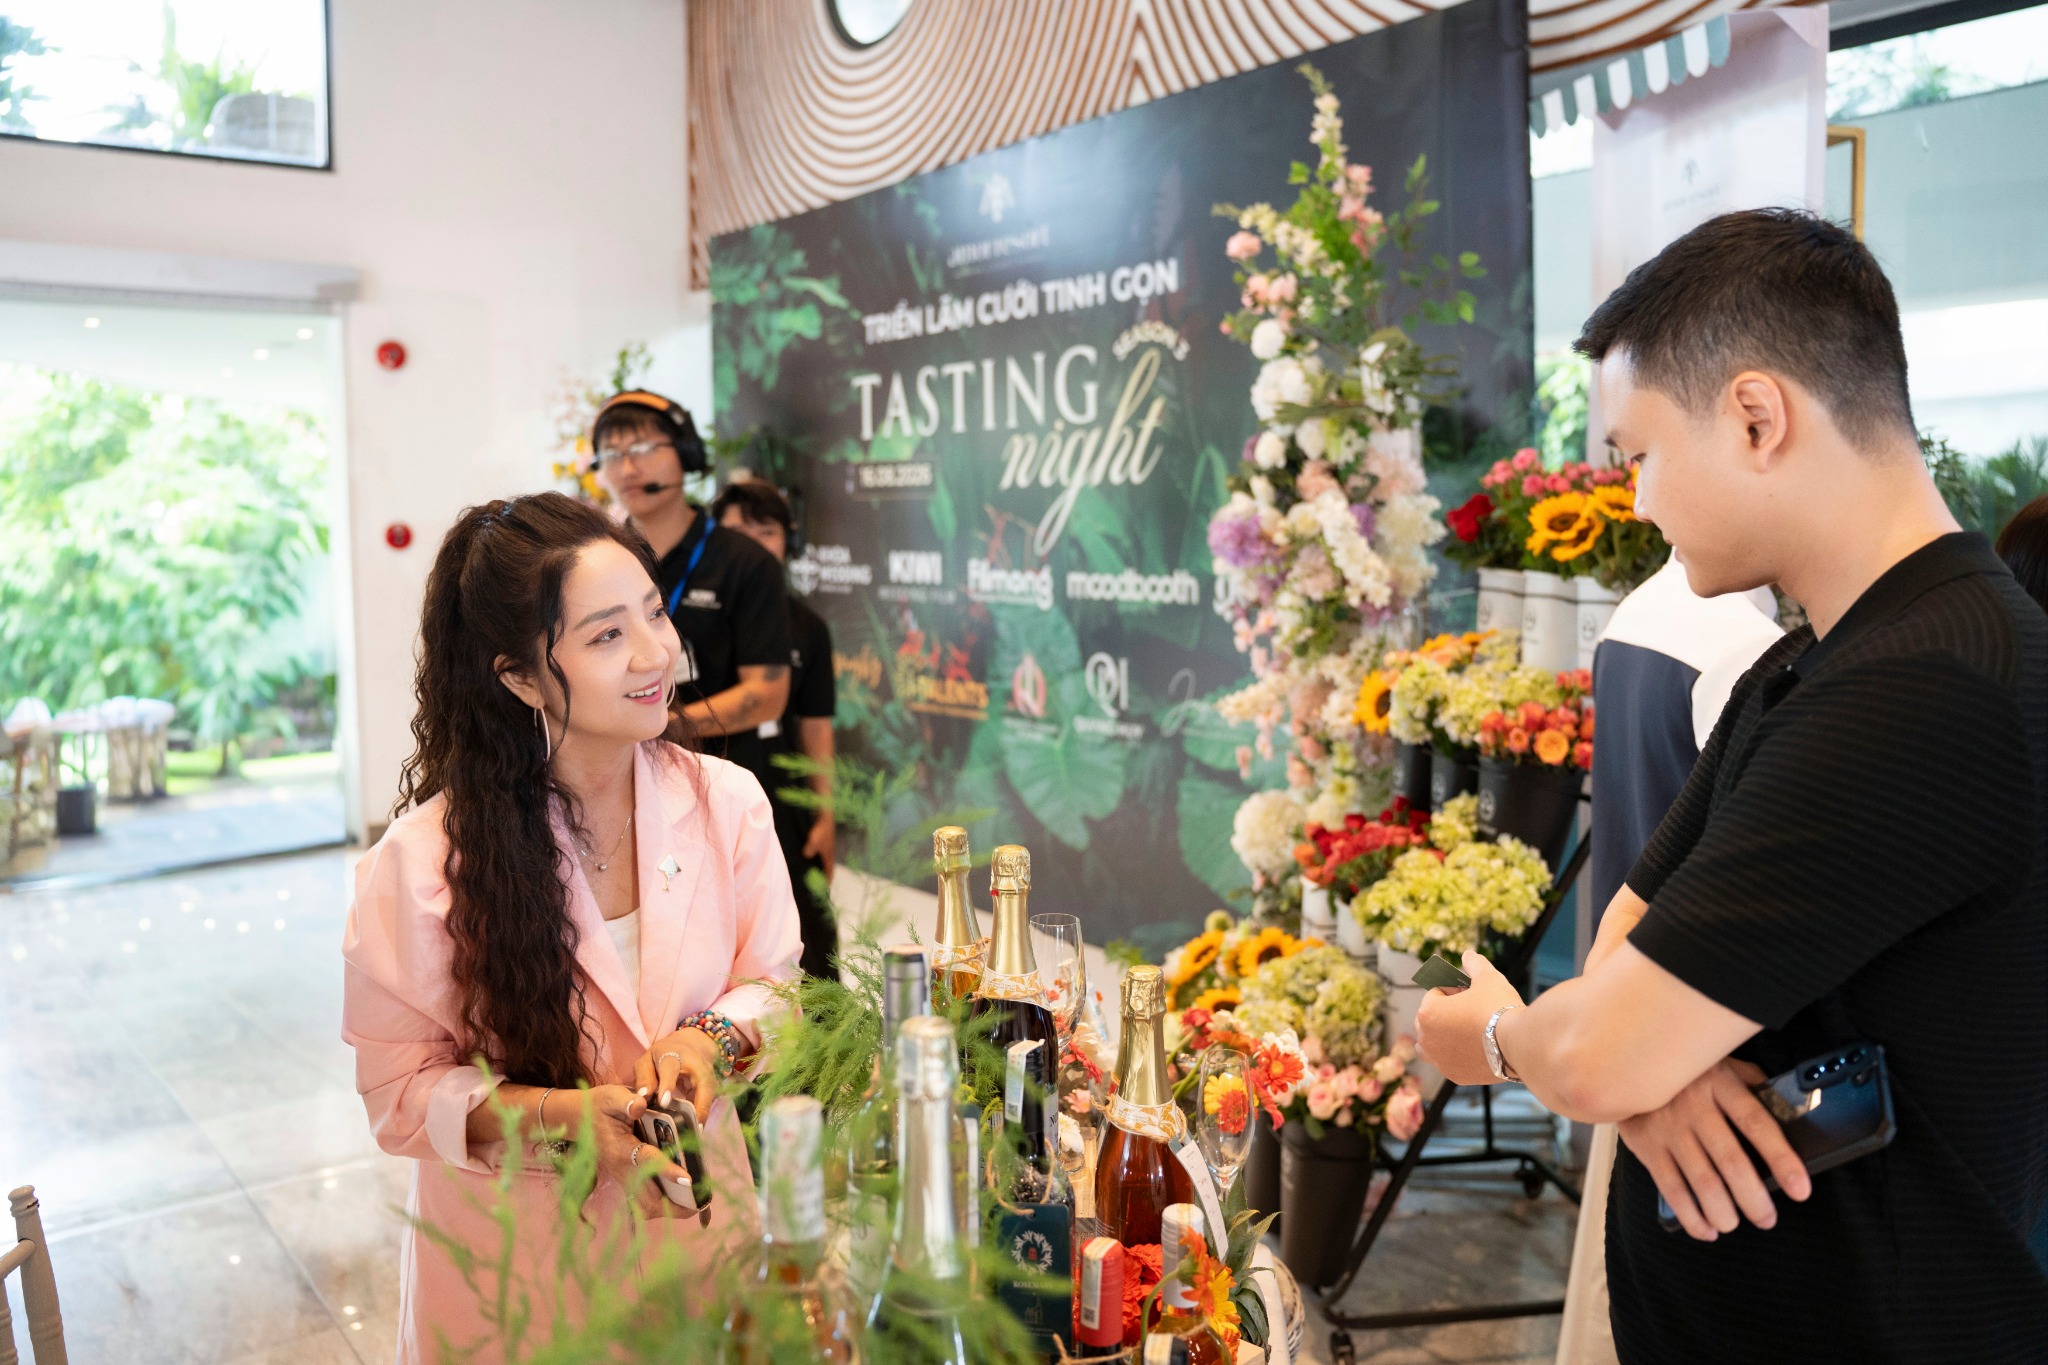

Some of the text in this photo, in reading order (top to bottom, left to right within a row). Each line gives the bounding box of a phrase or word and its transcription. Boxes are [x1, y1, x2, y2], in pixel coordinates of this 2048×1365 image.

[1041, 271, 1107, 314] TINH
[1110, 257, 1179, 307] GỌN
[851, 345, 1100, 441] TASTING
[1000, 347, 1167, 557] night
[888, 550, 943, 585] KIWI
[1066, 568, 1199, 605] moodbooth
